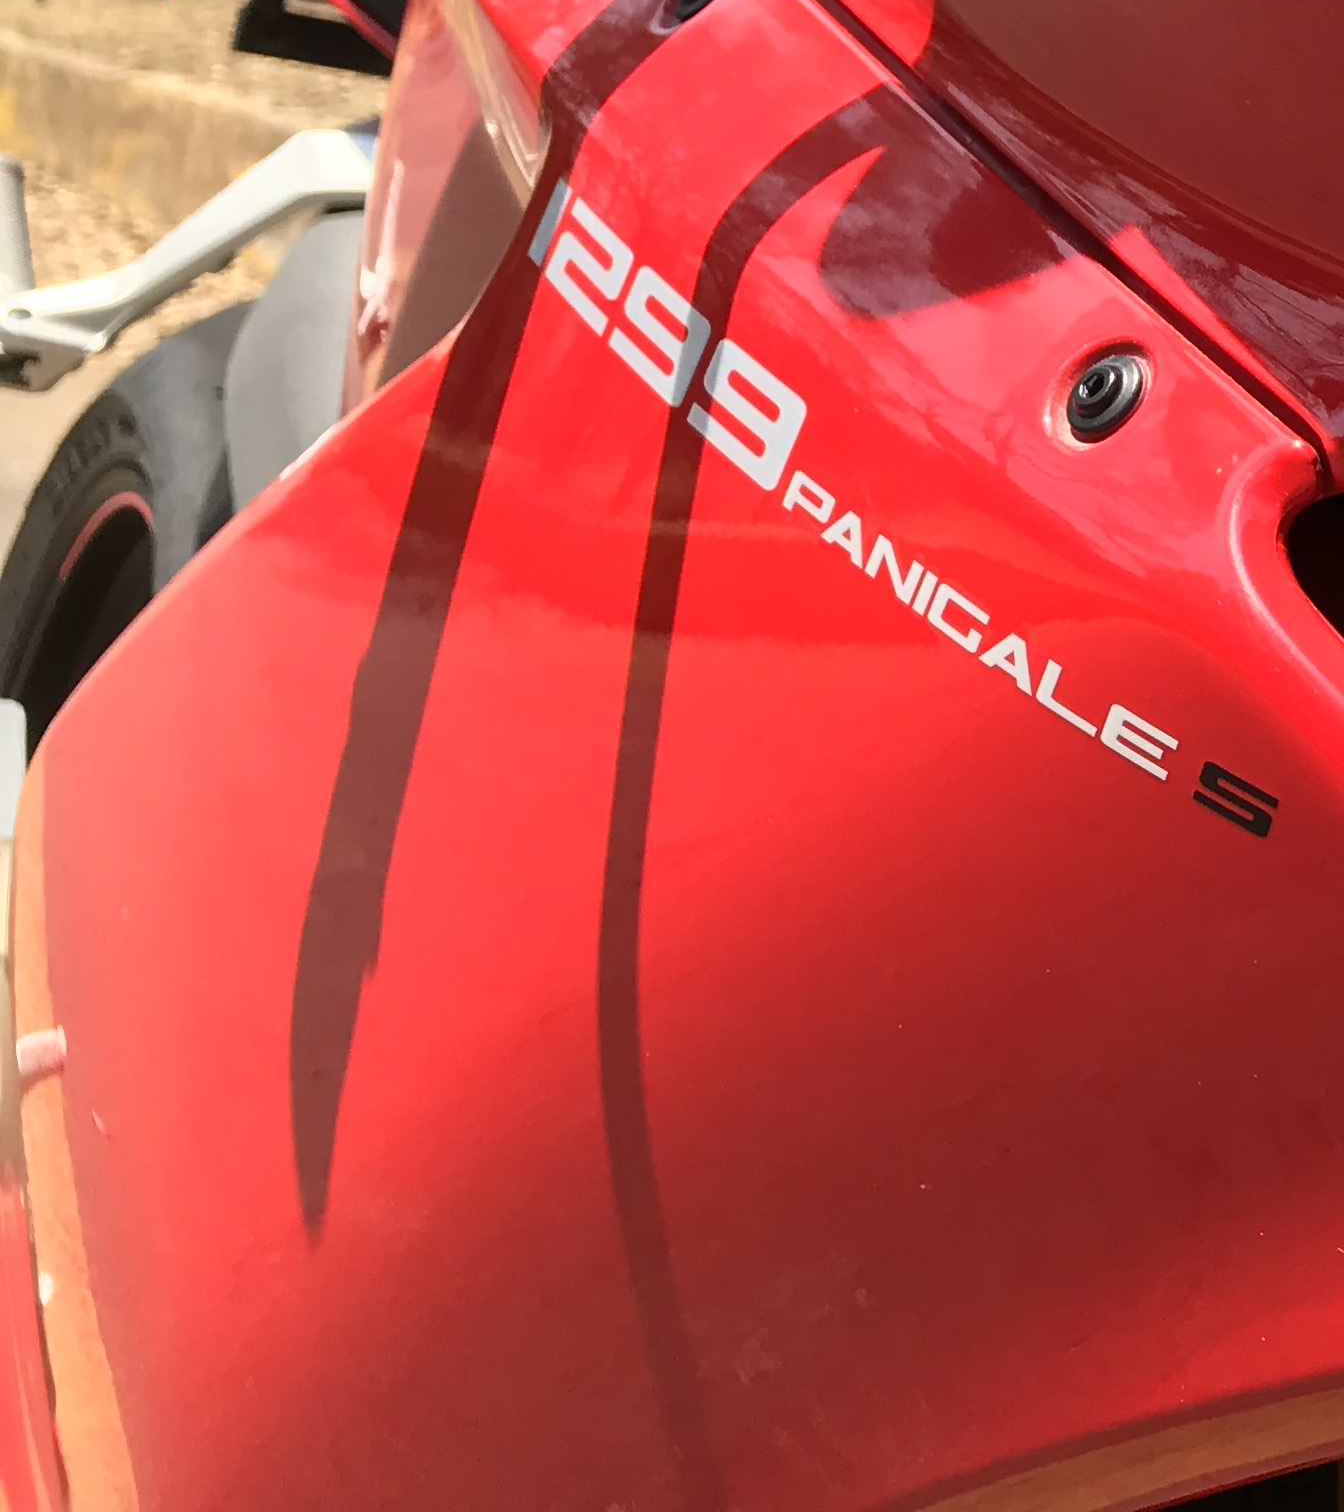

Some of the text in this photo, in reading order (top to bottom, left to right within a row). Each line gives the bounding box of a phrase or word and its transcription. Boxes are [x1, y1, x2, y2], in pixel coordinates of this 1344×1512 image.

[527, 178, 1280, 838] 1299 PANIGALE S
